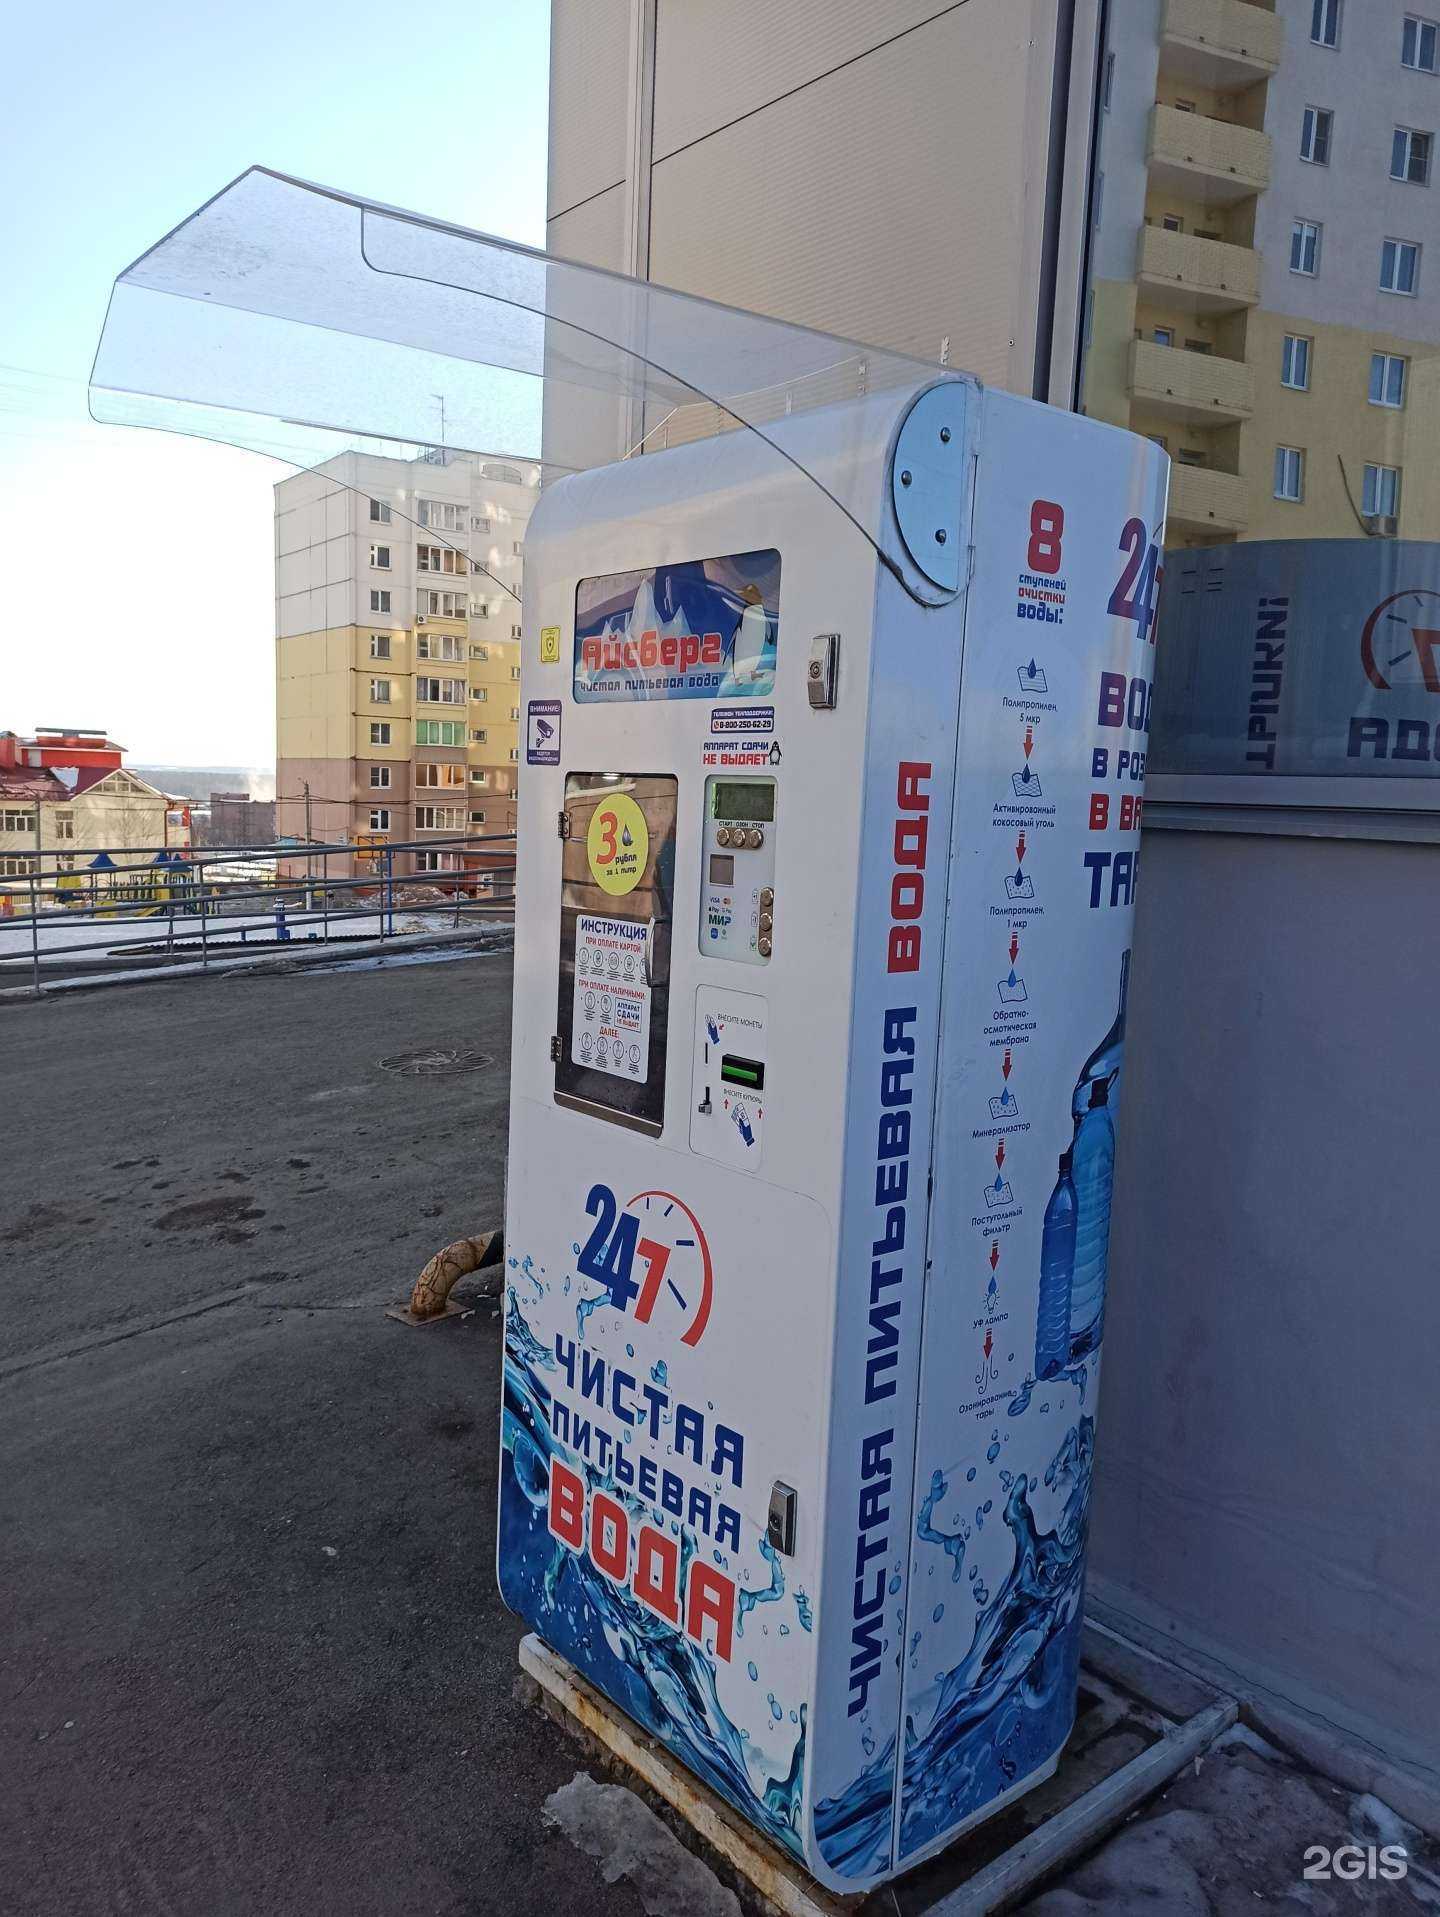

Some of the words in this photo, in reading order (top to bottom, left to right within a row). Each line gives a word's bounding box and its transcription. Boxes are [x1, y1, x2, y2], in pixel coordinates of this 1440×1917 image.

[1027, 499, 1064, 575] 8
[1018, 574, 1066, 590] ступеней
[1018, 587, 1065, 604] очистки
[1017, 602, 1063, 624] воды:
[582, 630, 722, 673] Айсберг
[580, 680, 621, 692] чистая
[624, 676, 684, 691] питьевая
[688, 672, 720, 689] вода
[1098, 671, 1151, 733] ВО
[1019, 713, 1025, 722] 5
[1026, 715, 1041, 724] мкр
[703, 742, 739, 751] АППАРАТ
[741, 741, 769, 751] СДАЧИ
[703, 754, 717, 765] НЕ
[720, 753, 769, 765] ВЫДАЕТ
[1091, 747, 1109, 778] В
[993, 803, 1056, 816] Активированный
[1089, 793, 1109, 831] В
[993, 816, 1034, 827] кокосовый
[1035, 818, 1055, 830] уголь
[596, 811, 618, 865] 3
[887, 761, 932, 974] ВОДА
[708, 914, 732, 926] МИР
[1012, 920, 1028, 929] мкр
[581, 919, 647, 940] ИНСТРУКЦИЯ
[597, 939, 619, 949] ОПЛАТЕ
[578, 979, 589, 988] ПРИ
[590, 981, 610, 992] ОПЛАТЕ
[616, 1010, 640, 1021] СДАЧИ
[617, 1003, 640, 1012] АППАРАТ
[993, 1011, 1029, 1022] Обратно-
[983, 1021, 1037, 1035] осмотическая
[989, 1035, 1030, 1048] мембрана
[972, 1121, 1031, 1139] Минерализатор
[864, 1006, 918, 1406] ПИТЬЕВАЯ
[971, 1206, 1023, 1227] Постугольный
[982, 1223, 1011, 1237] фильтр
[972, 1318, 984, 1329] УФ
[984, 1312, 1009, 1326] лампа
[555, 1332, 744, 1488] ЧИСТАЯ
[975, 1408, 995, 1420] тары
[552, 1398, 742, 1554] ПИТЬЕВАЯ
[548, 1459, 737, 1664] ВОДА
[847, 1428, 894, 1718] ЧИСТАЯ
